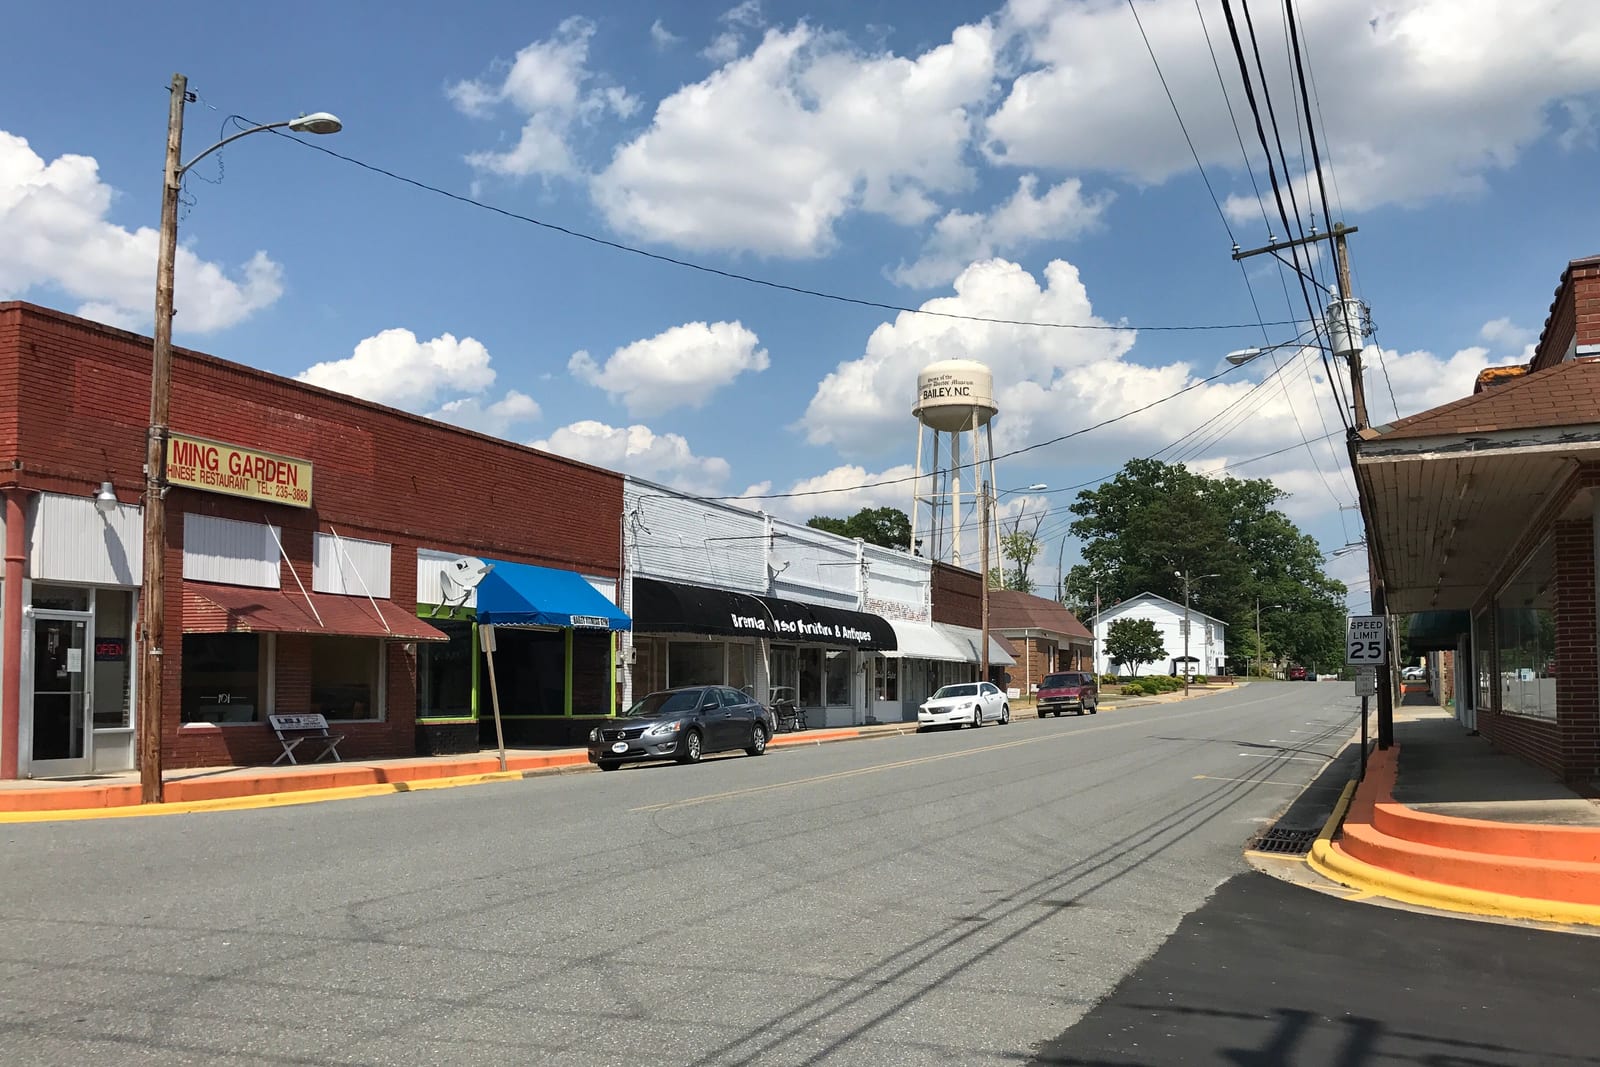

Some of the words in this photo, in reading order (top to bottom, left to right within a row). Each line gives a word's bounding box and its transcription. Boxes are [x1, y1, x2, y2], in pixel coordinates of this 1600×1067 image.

[173, 439, 219, 472] MING
[228, 451, 298, 487] GARDEN
[167, 463, 196, 482] HINESE
[199, 469, 250, 492] RESTAURANT
[256, 479, 273, 496] TEL:
[275, 484, 308, 503] 235-3888
[834, 624, 841, 638] &
[842, 625, 872, 643] Antiques
[1350, 621, 1383, 630] SPEED
[1353, 631, 1379, 640] LIMIT
[95, 643, 124, 656] OPEN
[1350, 641, 1382, 659] 25
